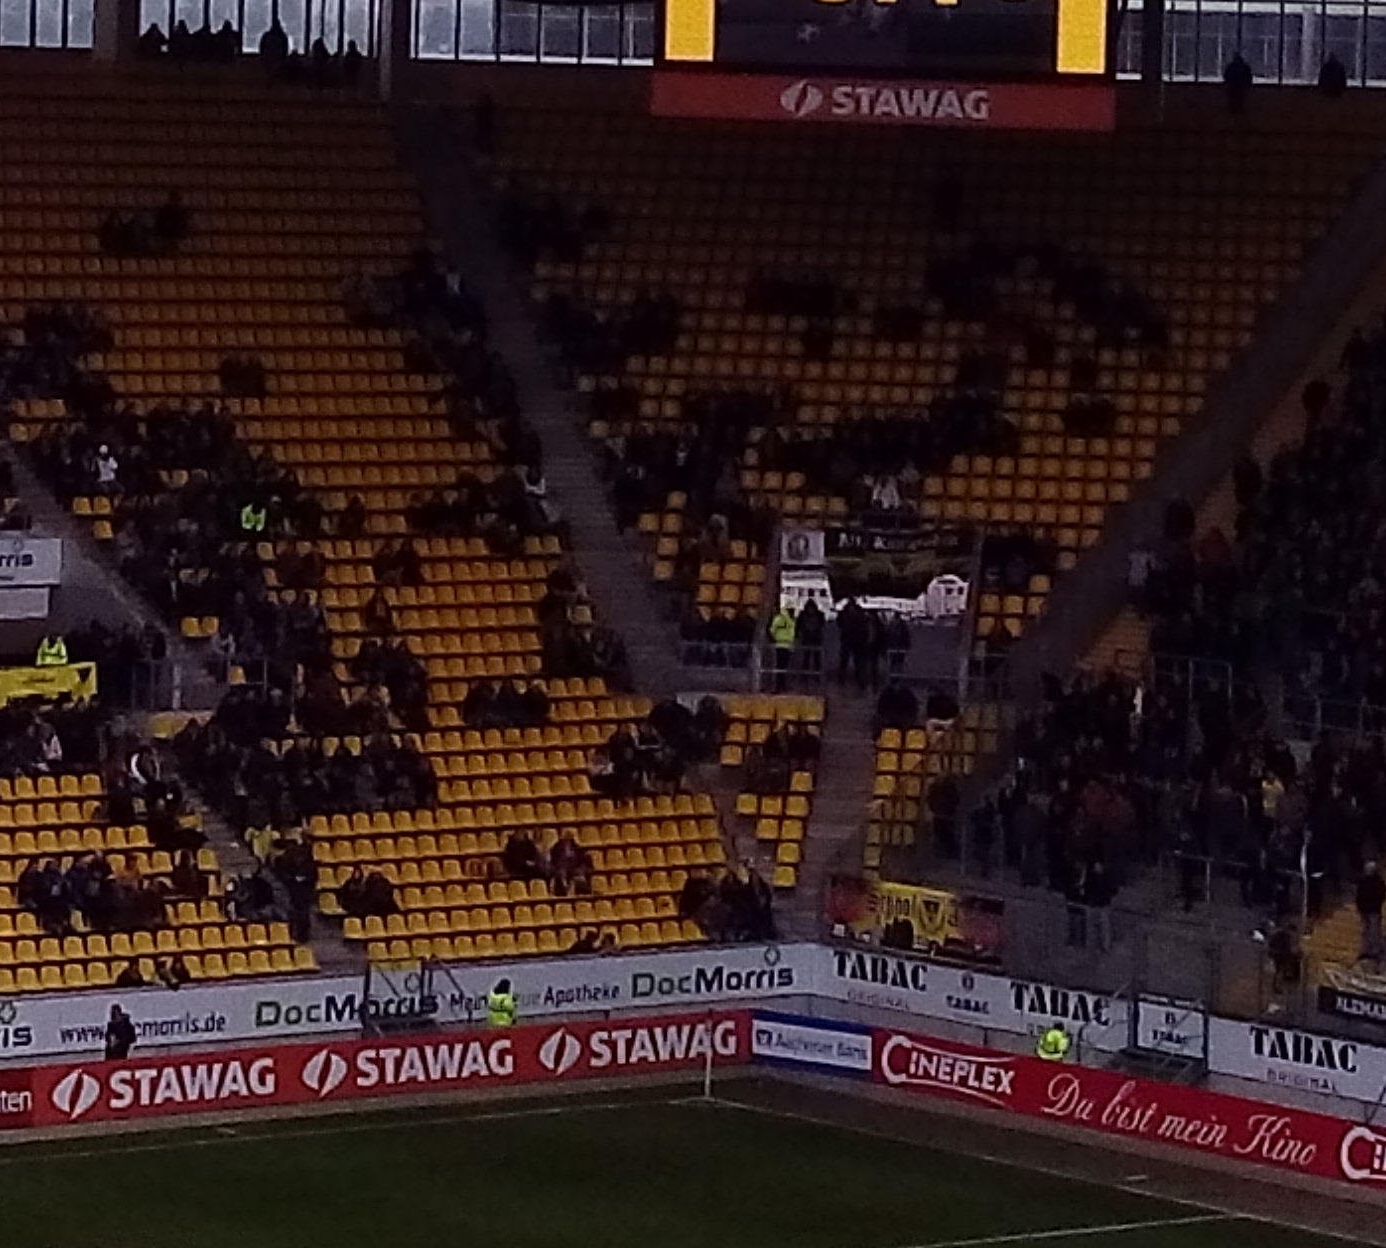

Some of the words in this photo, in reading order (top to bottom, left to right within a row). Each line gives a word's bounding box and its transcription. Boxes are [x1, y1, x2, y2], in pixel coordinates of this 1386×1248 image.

[832, 87, 990, 120] STAWAG
[544, 983, 621, 1005] Apotheke
[631, 965, 794, 998] DocMorris
[832, 951, 928, 992] TABAC
[1010, 981, 1111, 1027] TABAC
[357, 1039, 514, 1087] STAWAG
[588, 1019, 738, 1068] STAWAG
[881, 1035, 1014, 1096] CINEPLEX
[1248, 1025, 1357, 1074] TABAC
[108, 1057, 276, 1109] STAWAG
[1266, 1067, 1338, 1093] ORIGINAL
[1040, 1072, 1094, 1121] Du
[1100, 1080, 1158, 1133] bist
[1157, 1114, 1229, 1148] mein
[1232, 1113, 1317, 1166] Kino
